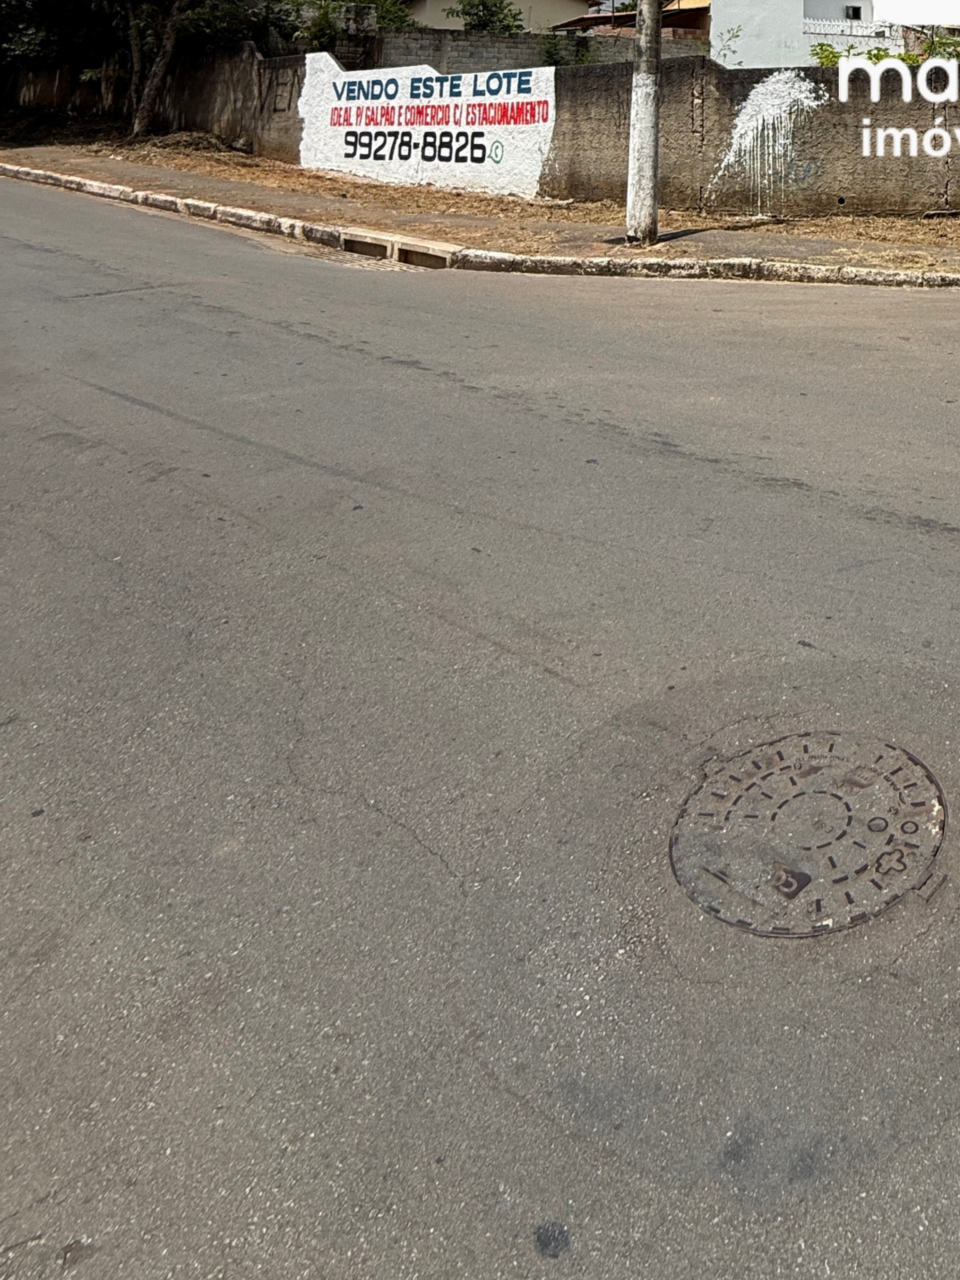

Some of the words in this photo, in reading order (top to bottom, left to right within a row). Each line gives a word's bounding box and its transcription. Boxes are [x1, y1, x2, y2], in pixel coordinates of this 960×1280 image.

[332, 78, 399, 101] VENDO
[410, 75, 462, 99] ESTE
[472, 71, 533, 97] LOTE
[330, 106, 353, 127] IDEAL
[397, 105, 403, 126] E
[404, 100, 450, 126] COMÉRCIO
[453, 103, 463, 127] C/
[465, 100, 549, 126] ESTACIONAMENTO
[344, 131, 486, 164] 99278-8826
